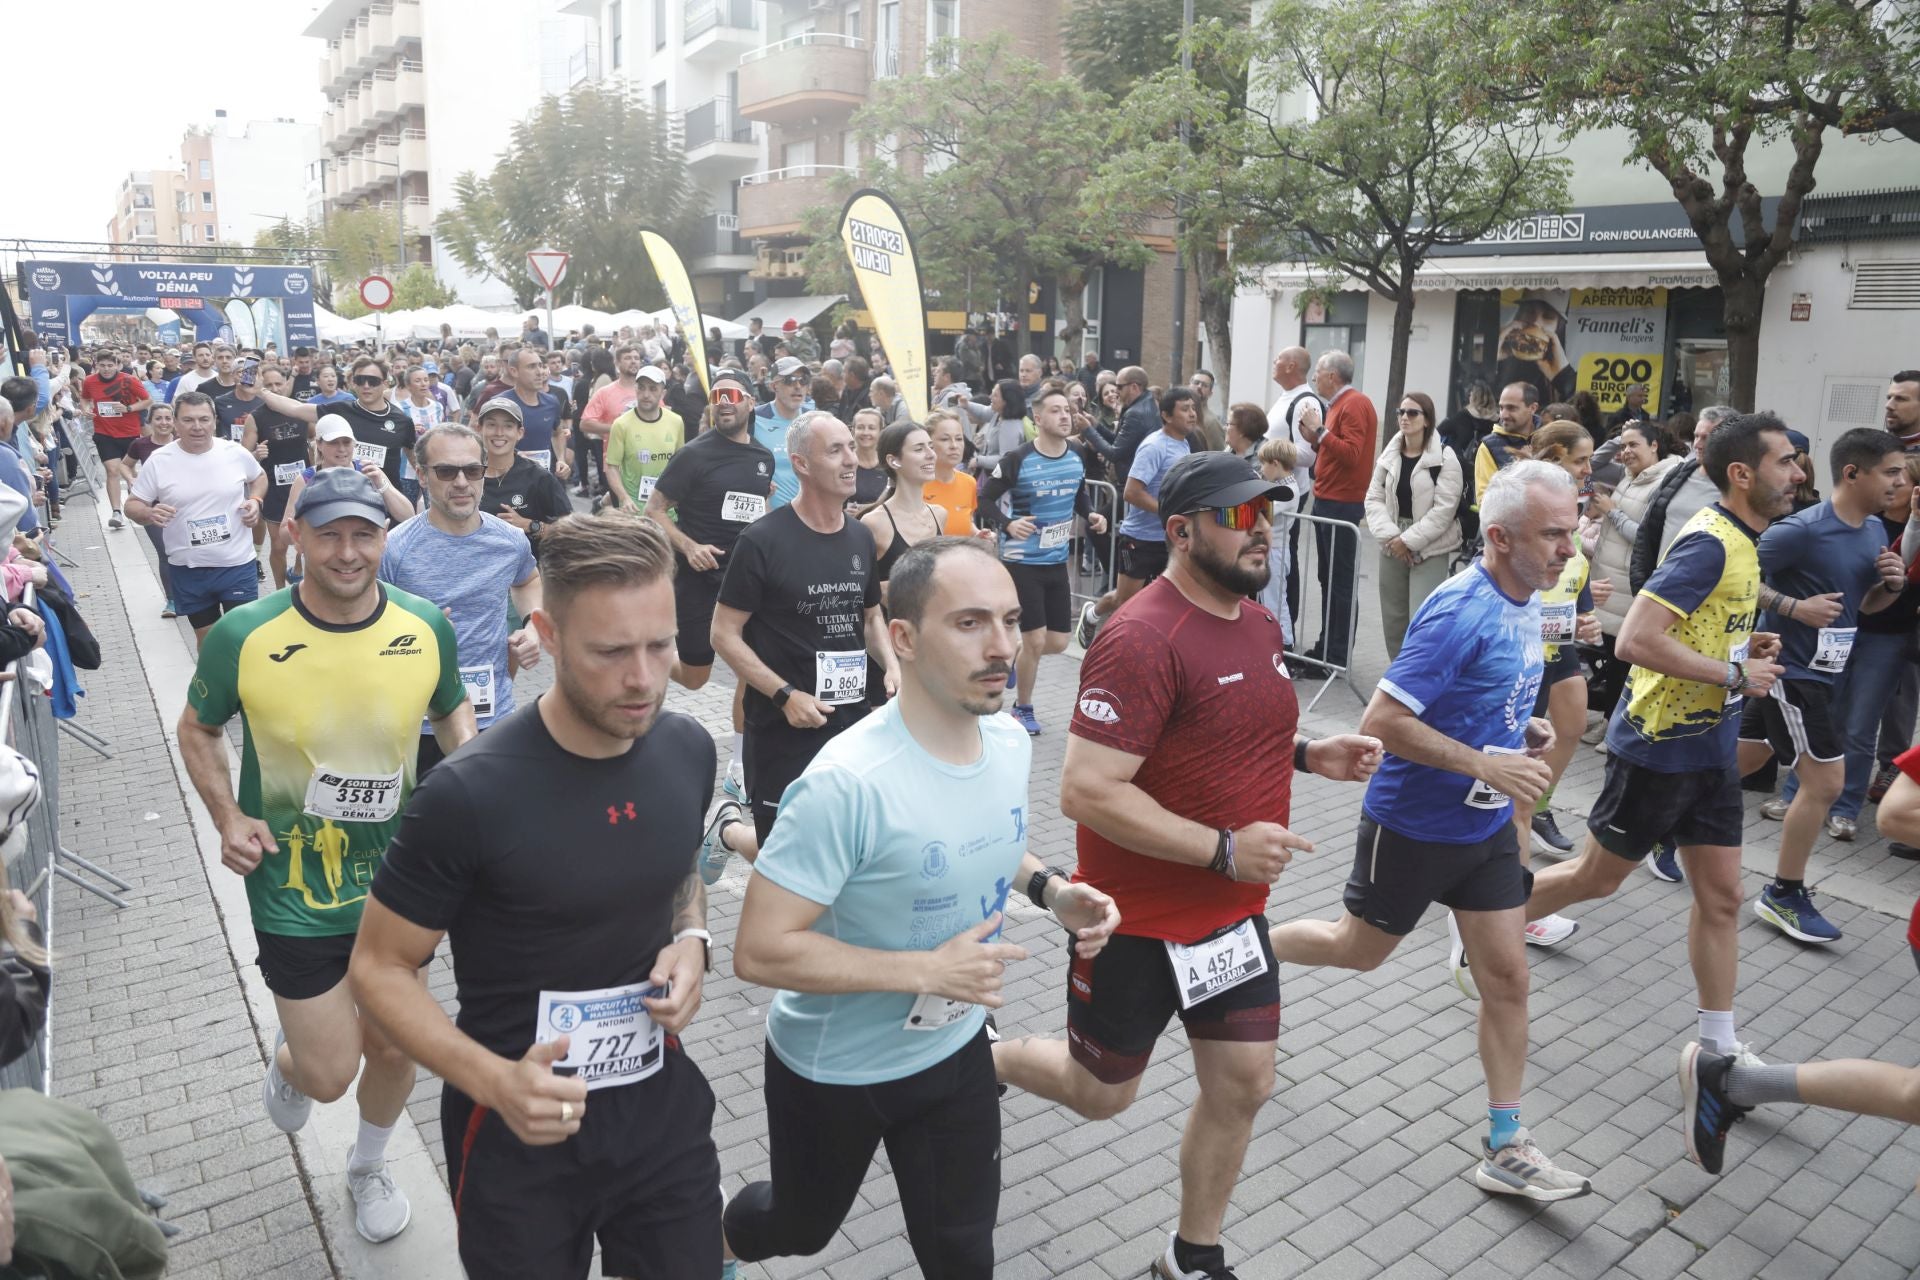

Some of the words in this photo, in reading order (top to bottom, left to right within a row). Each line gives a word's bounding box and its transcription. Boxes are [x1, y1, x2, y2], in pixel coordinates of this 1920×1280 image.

[138, 270, 177, 280] VOLTA
[178, 272, 189, 280] A
[189, 272, 213, 281] PEU
[1412, 279, 1446, 287] BRADOR
[1512, 276, 1559, 286] CAFETERÍA
[156, 280, 199, 293] DÉNIA
[1581, 295, 1654, 306] APERTURA
[1577, 316, 1655, 334] Fanneli's
[1591, 358, 1652, 383] 200
[1590, 381, 1650, 393] BURGS
[733, 502, 755, 512] 3473
[202, 529, 218, 539] 538
[808, 582, 862, 595] KARMAVIDA
[824, 678, 833, 689] D
[839, 676, 858, 690] 860
[347, 780, 369, 788] SOM
[335, 788, 385, 804] 3581
[342, 810, 376, 818] DÉNIA
[1189, 966, 1200, 985] A
[1207, 948, 1234, 975] 457
[1205, 964, 1247, 991] BALEARIA
[590, 1007, 621, 1019] MARINA
[622, 1005, 642, 1015] ALTA
[596, 1016, 634, 1029] ANTONIO
[587, 1031, 638, 1062] 727
[576, 1056, 643, 1079] BALEARIA
